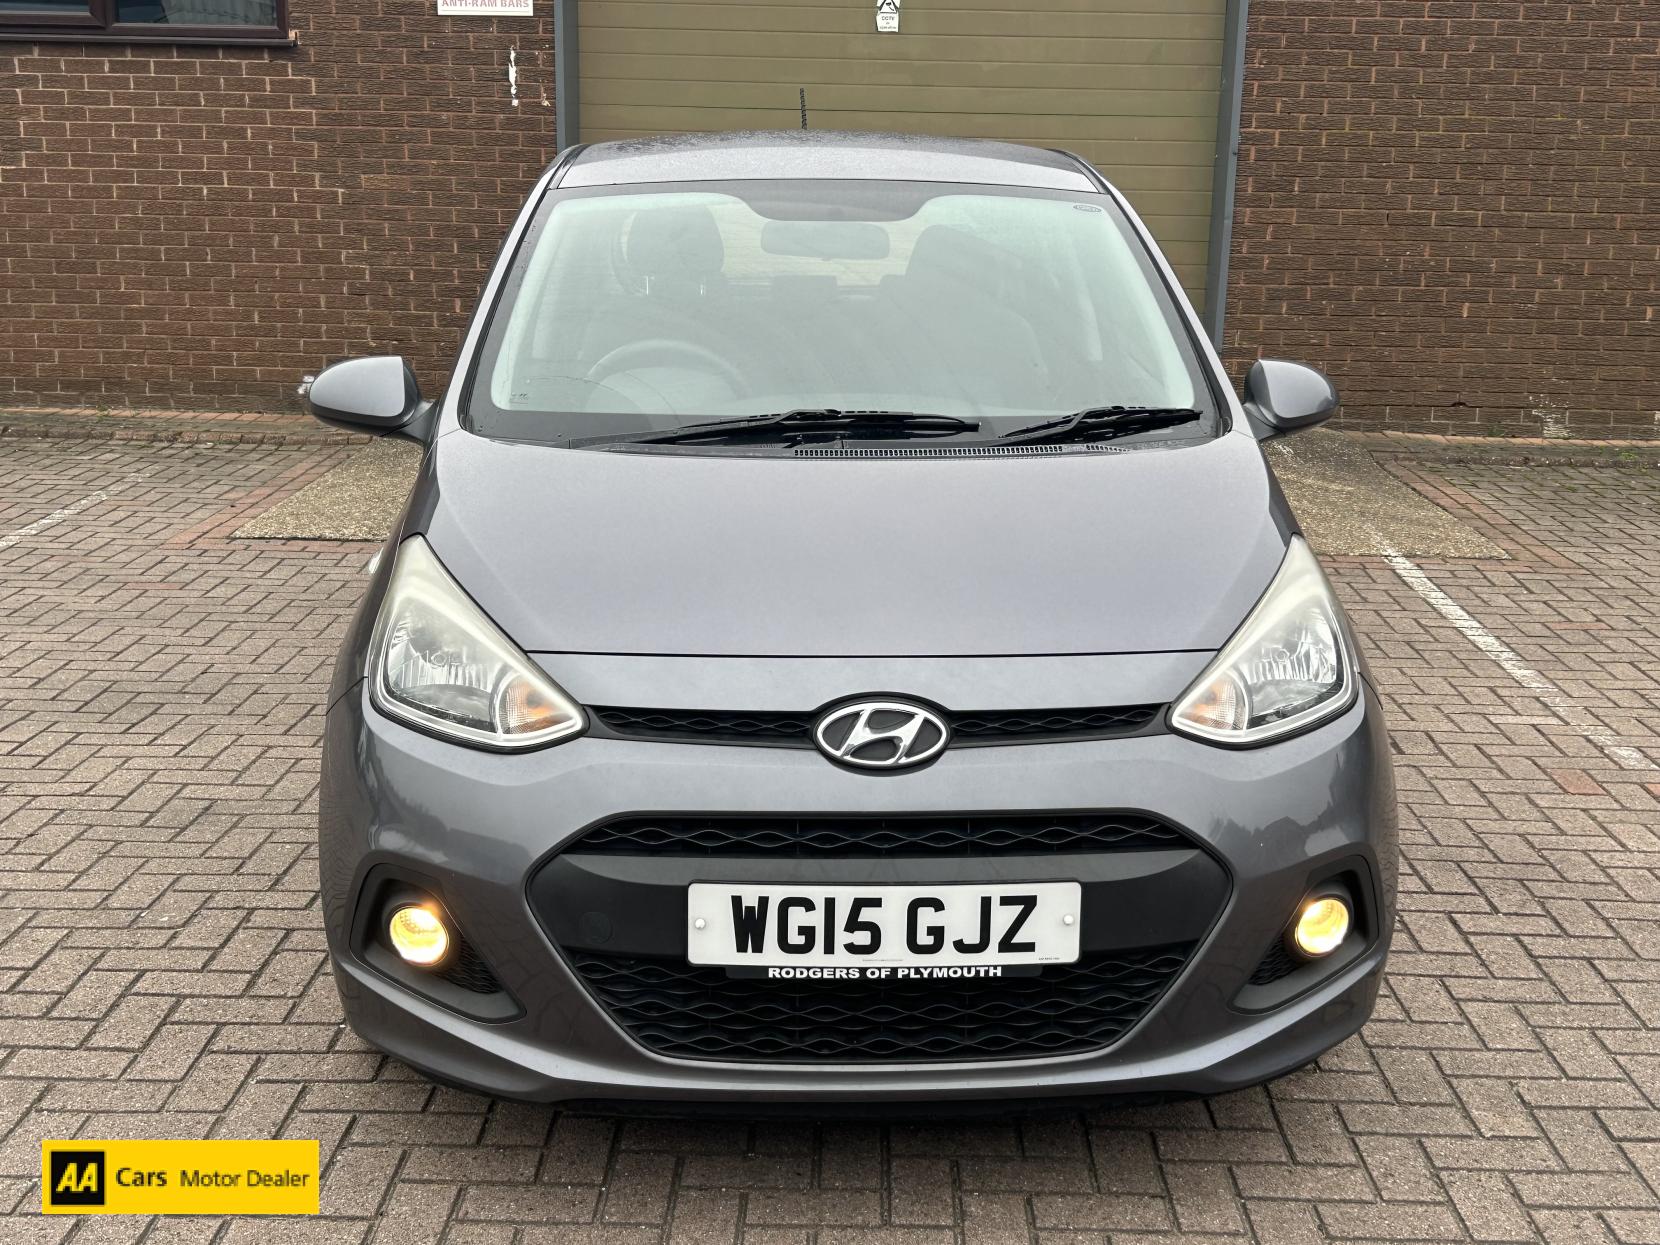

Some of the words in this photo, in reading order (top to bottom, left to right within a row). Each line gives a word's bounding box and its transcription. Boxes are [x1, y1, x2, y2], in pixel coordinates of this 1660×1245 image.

[500, 0, 530, 8] BARS
[731, 894, 883, 955] WG15
[905, 894, 1038, 955] GJZ
[768, 967, 860, 979] RODGERS
[866, 967, 891, 979] OF
[897, 966, 1002, 979] PLYMOUTH
